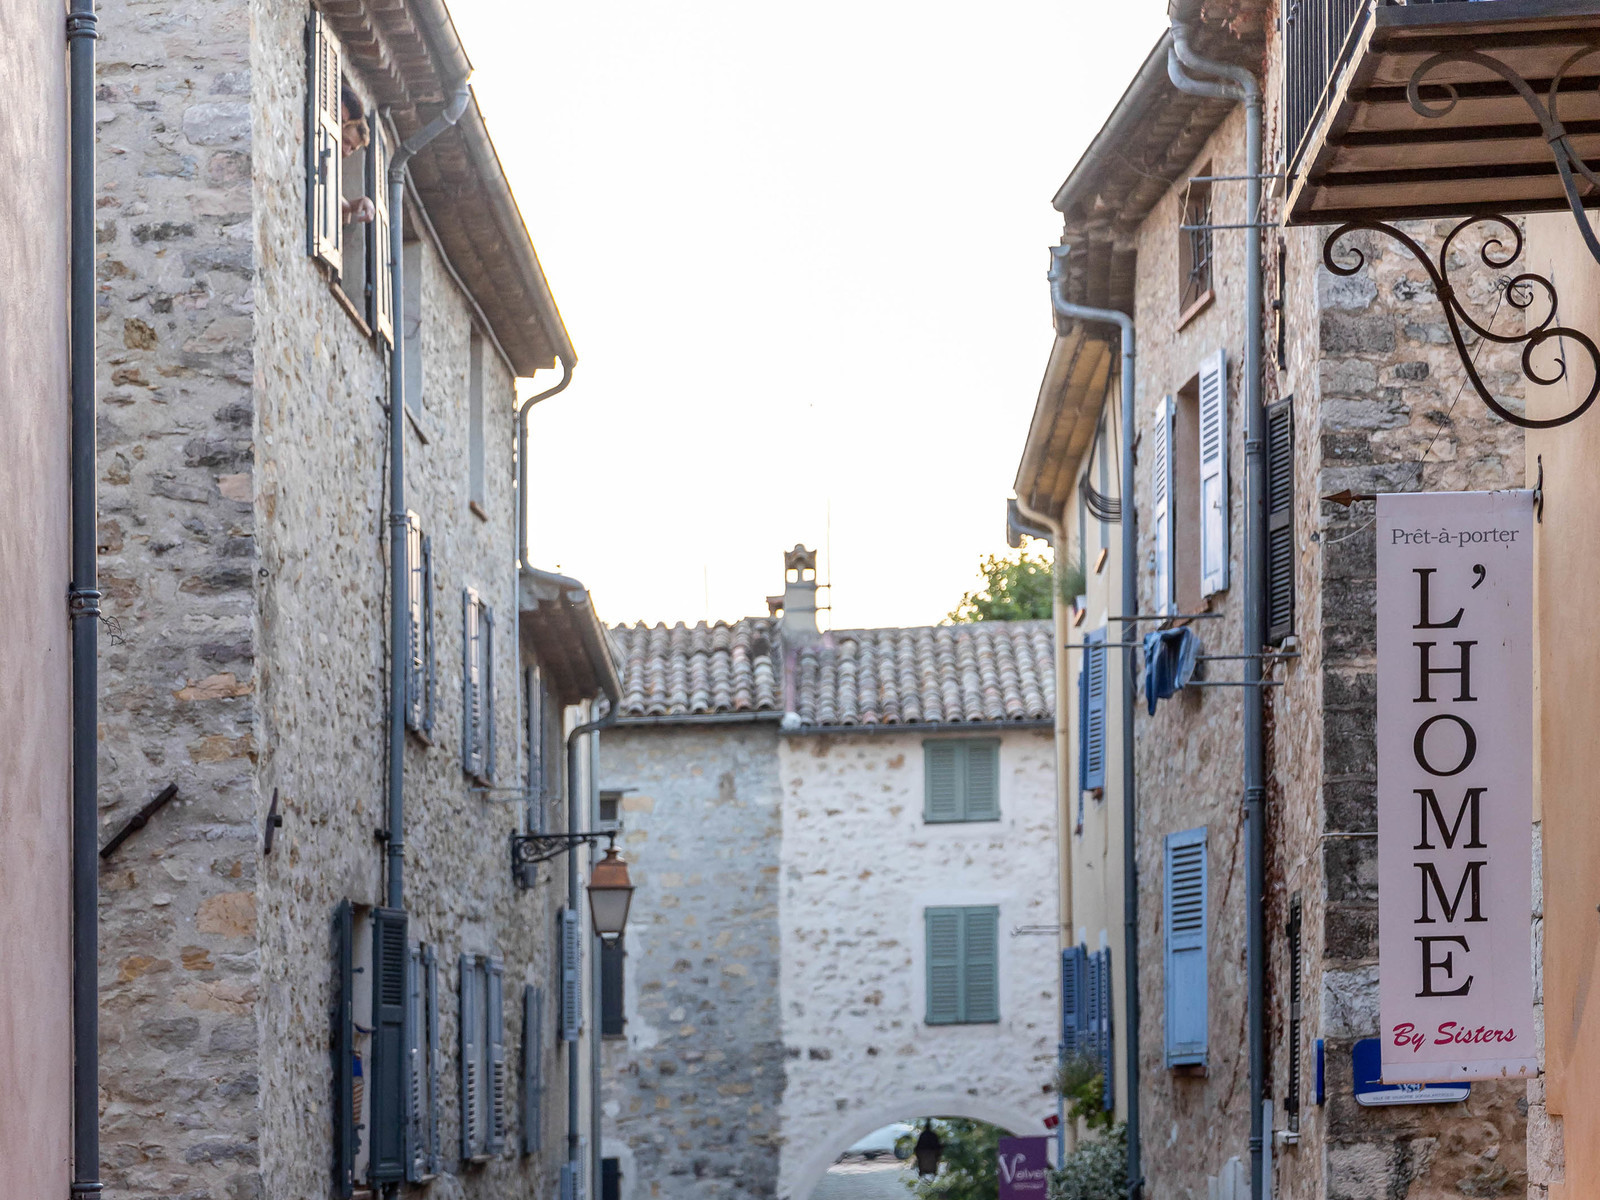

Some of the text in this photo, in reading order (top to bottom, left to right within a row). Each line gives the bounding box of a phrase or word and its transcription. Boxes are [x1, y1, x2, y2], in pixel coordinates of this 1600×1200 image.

[1391, 527, 1520, 548] Prêt-à-porter
[1412, 563, 1489, 999] L'HOMME
[1392, 1021, 1518, 1053] By Sisters
